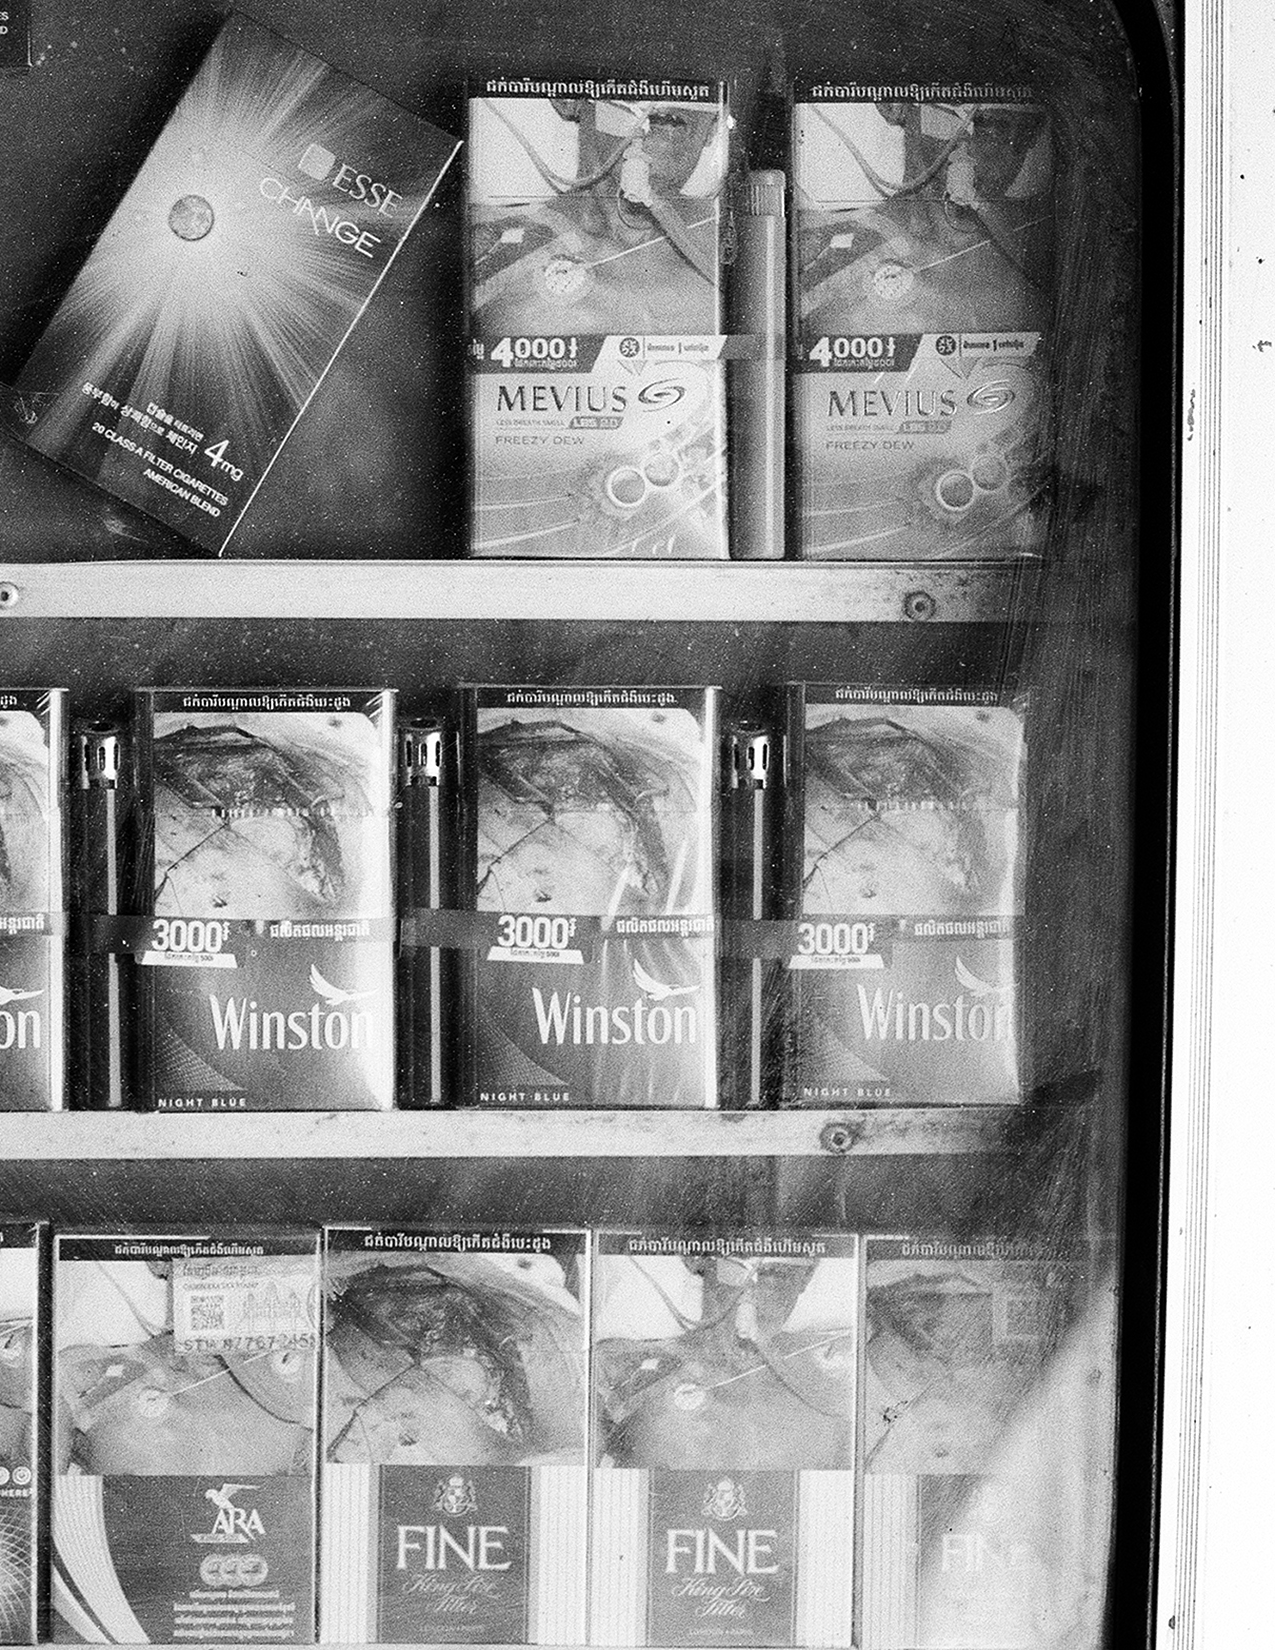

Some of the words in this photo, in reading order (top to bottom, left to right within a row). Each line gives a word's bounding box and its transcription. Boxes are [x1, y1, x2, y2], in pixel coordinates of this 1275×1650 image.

[332, 163, 404, 219] ESSE
[259, 177, 381, 259] CHANGE
[496, 385, 628, 413] MEVIUS
[827, 390, 958, 417] MEVIUS
[91, 422, 105, 435] 20
[104, 429, 138, 452] CLASS
[134, 446, 144, 456] A
[143, 450, 175, 474] FILTER
[173, 468, 229, 506] CIGARETTES
[143, 468, 192, 500] AMERICAN
[190, 494, 221, 518] BLEND
[209, 994, 374, 1051] Winston
[531, 987, 697, 1045] Winston
[158, 1098, 204, 1108] NIGHT
[211, 1097, 247, 1107] BLUE
[479, 1092, 526, 1101] NIGHT
[534, 1092, 570, 1101] BLUE
[803, 1087, 849, 1097] NIGHT
[857, 1087, 892, 1097] BLUE
[211, 1507, 266, 1541] ARA
[396, 1524, 512, 1572] FINE
[664, 1528, 780, 1575] FINE
